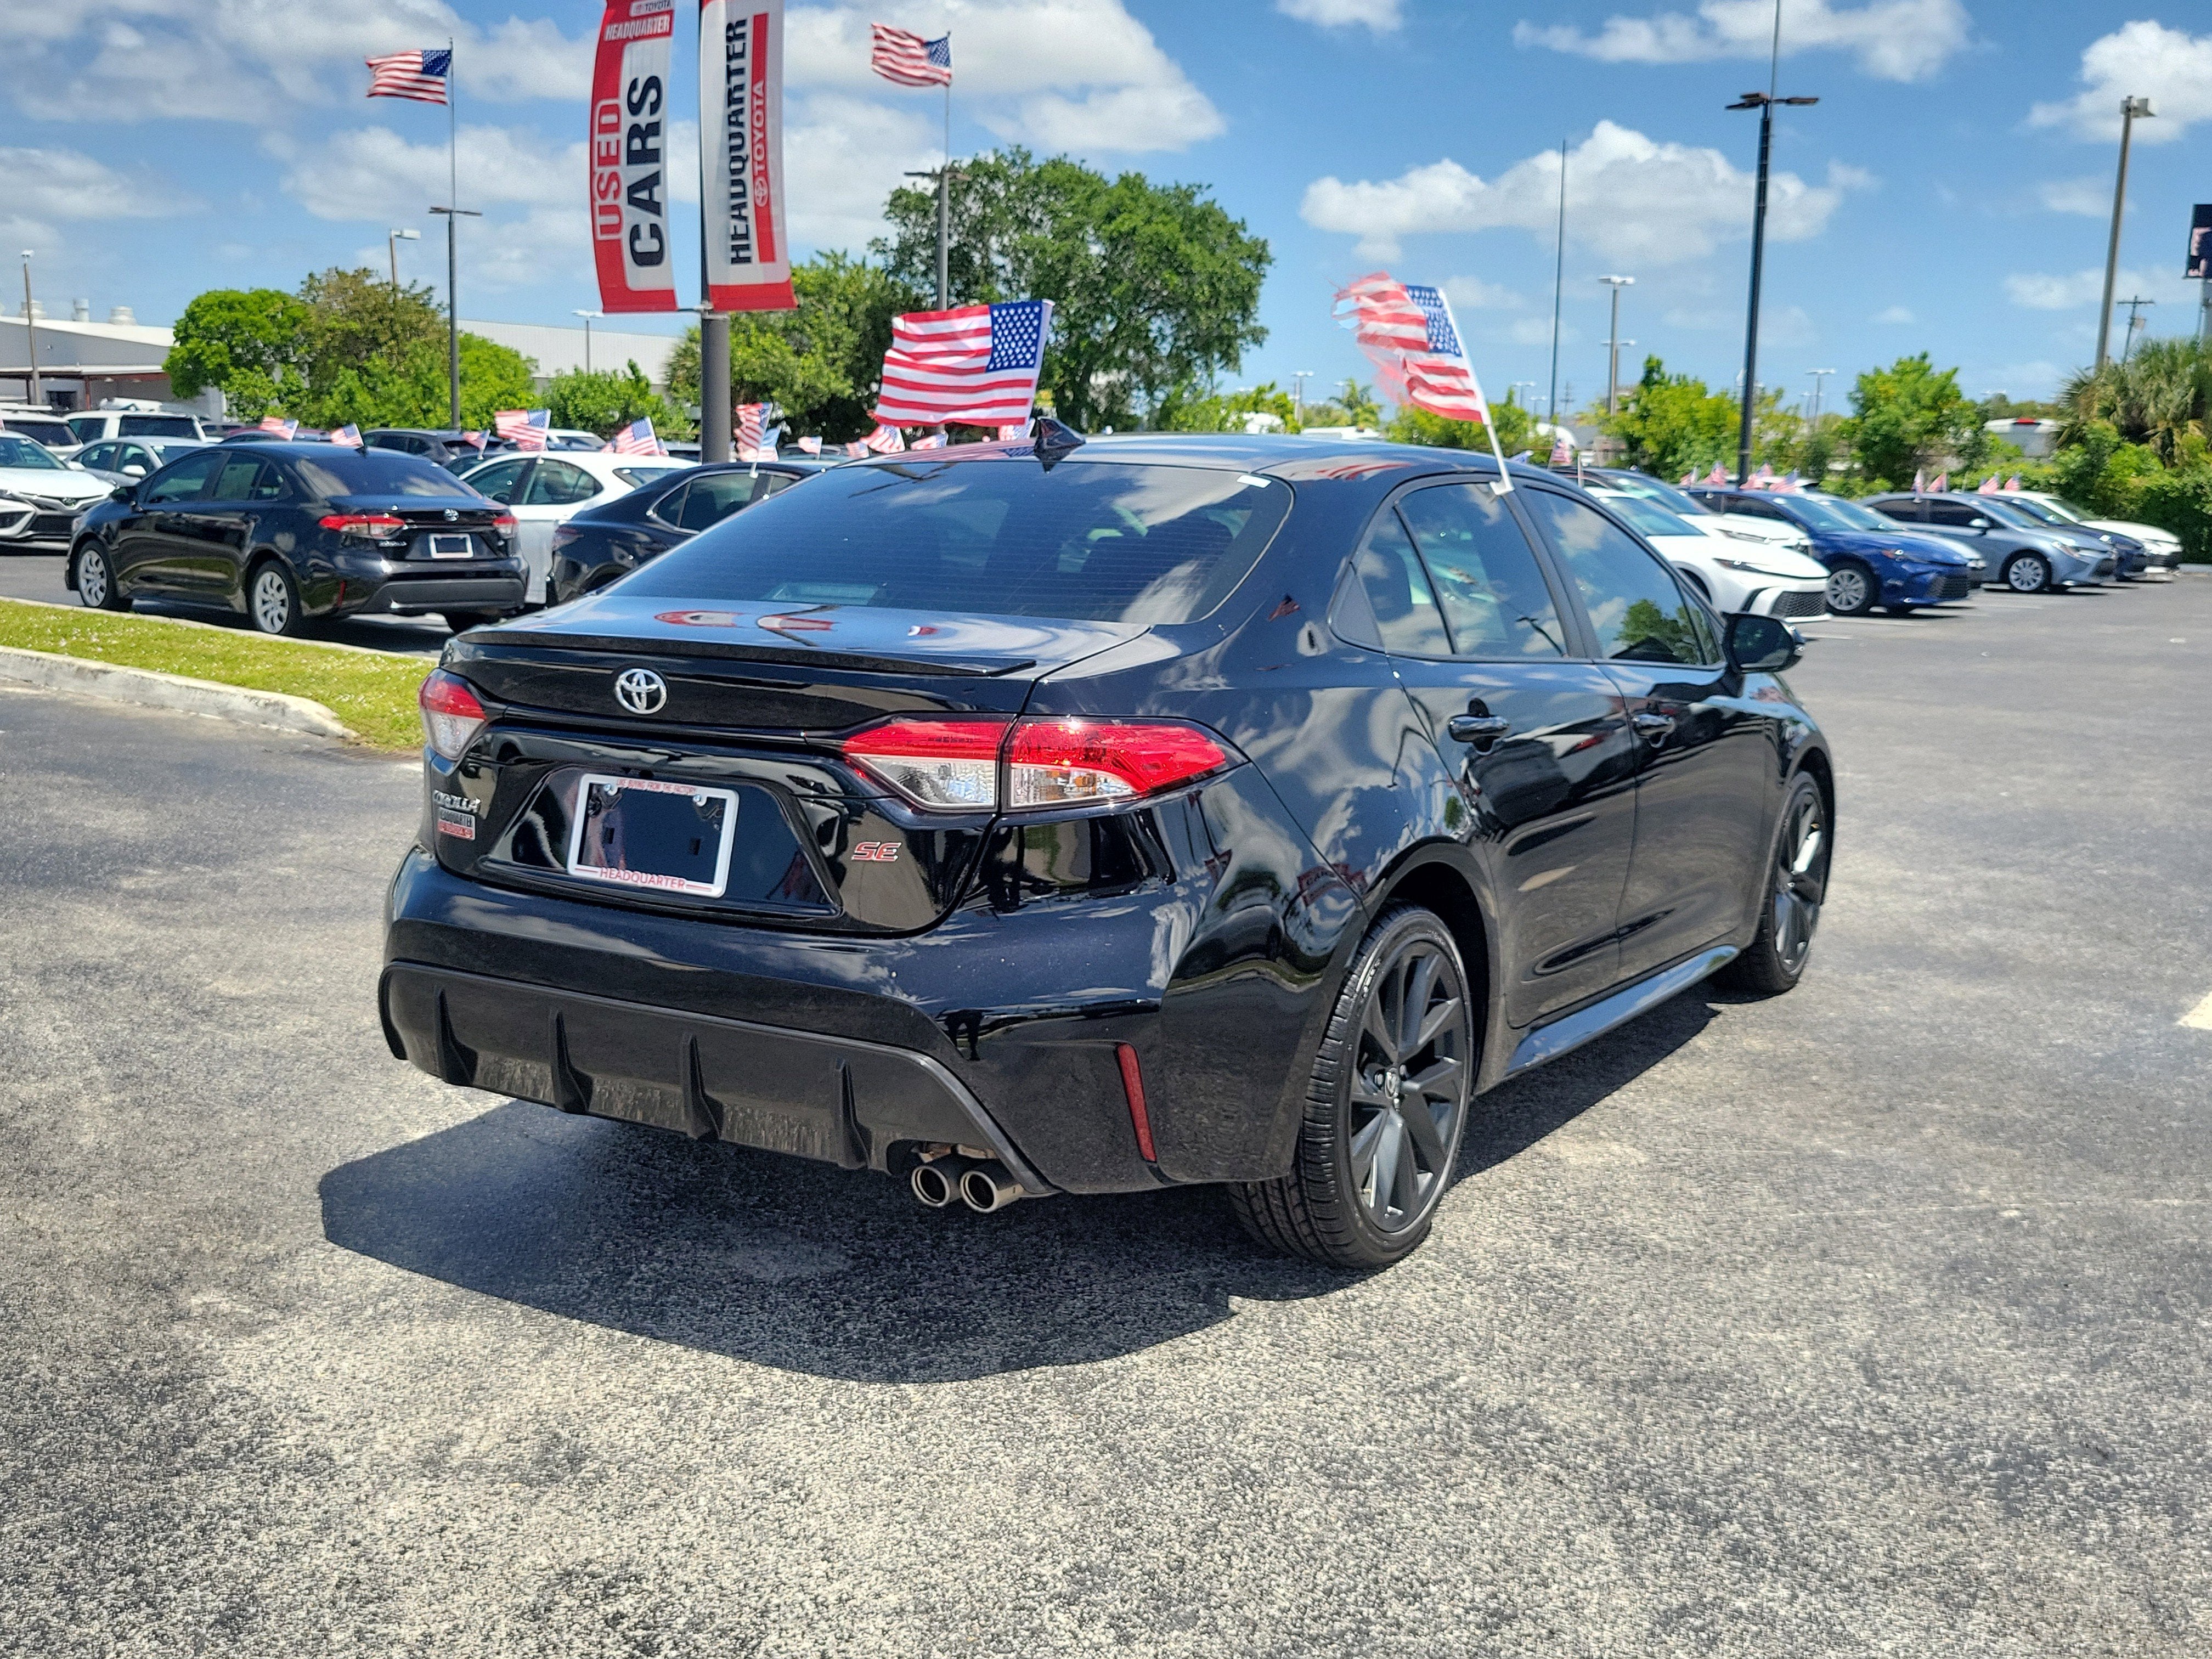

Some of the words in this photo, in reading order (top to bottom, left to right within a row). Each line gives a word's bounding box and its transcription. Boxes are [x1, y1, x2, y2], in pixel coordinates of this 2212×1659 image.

[605, 15, 670, 41] HEADQUARTER
[645, 0, 672, 11] TOYOTA
[726, 19, 752, 265] HEADQUARTER
[753, 81, 765, 175] TOYOTA
[596, 100, 624, 240] USED
[627, 75, 666, 267] CARS
[600, 867, 686, 890] HEADQUARTER
[851, 842, 902, 862] SE
